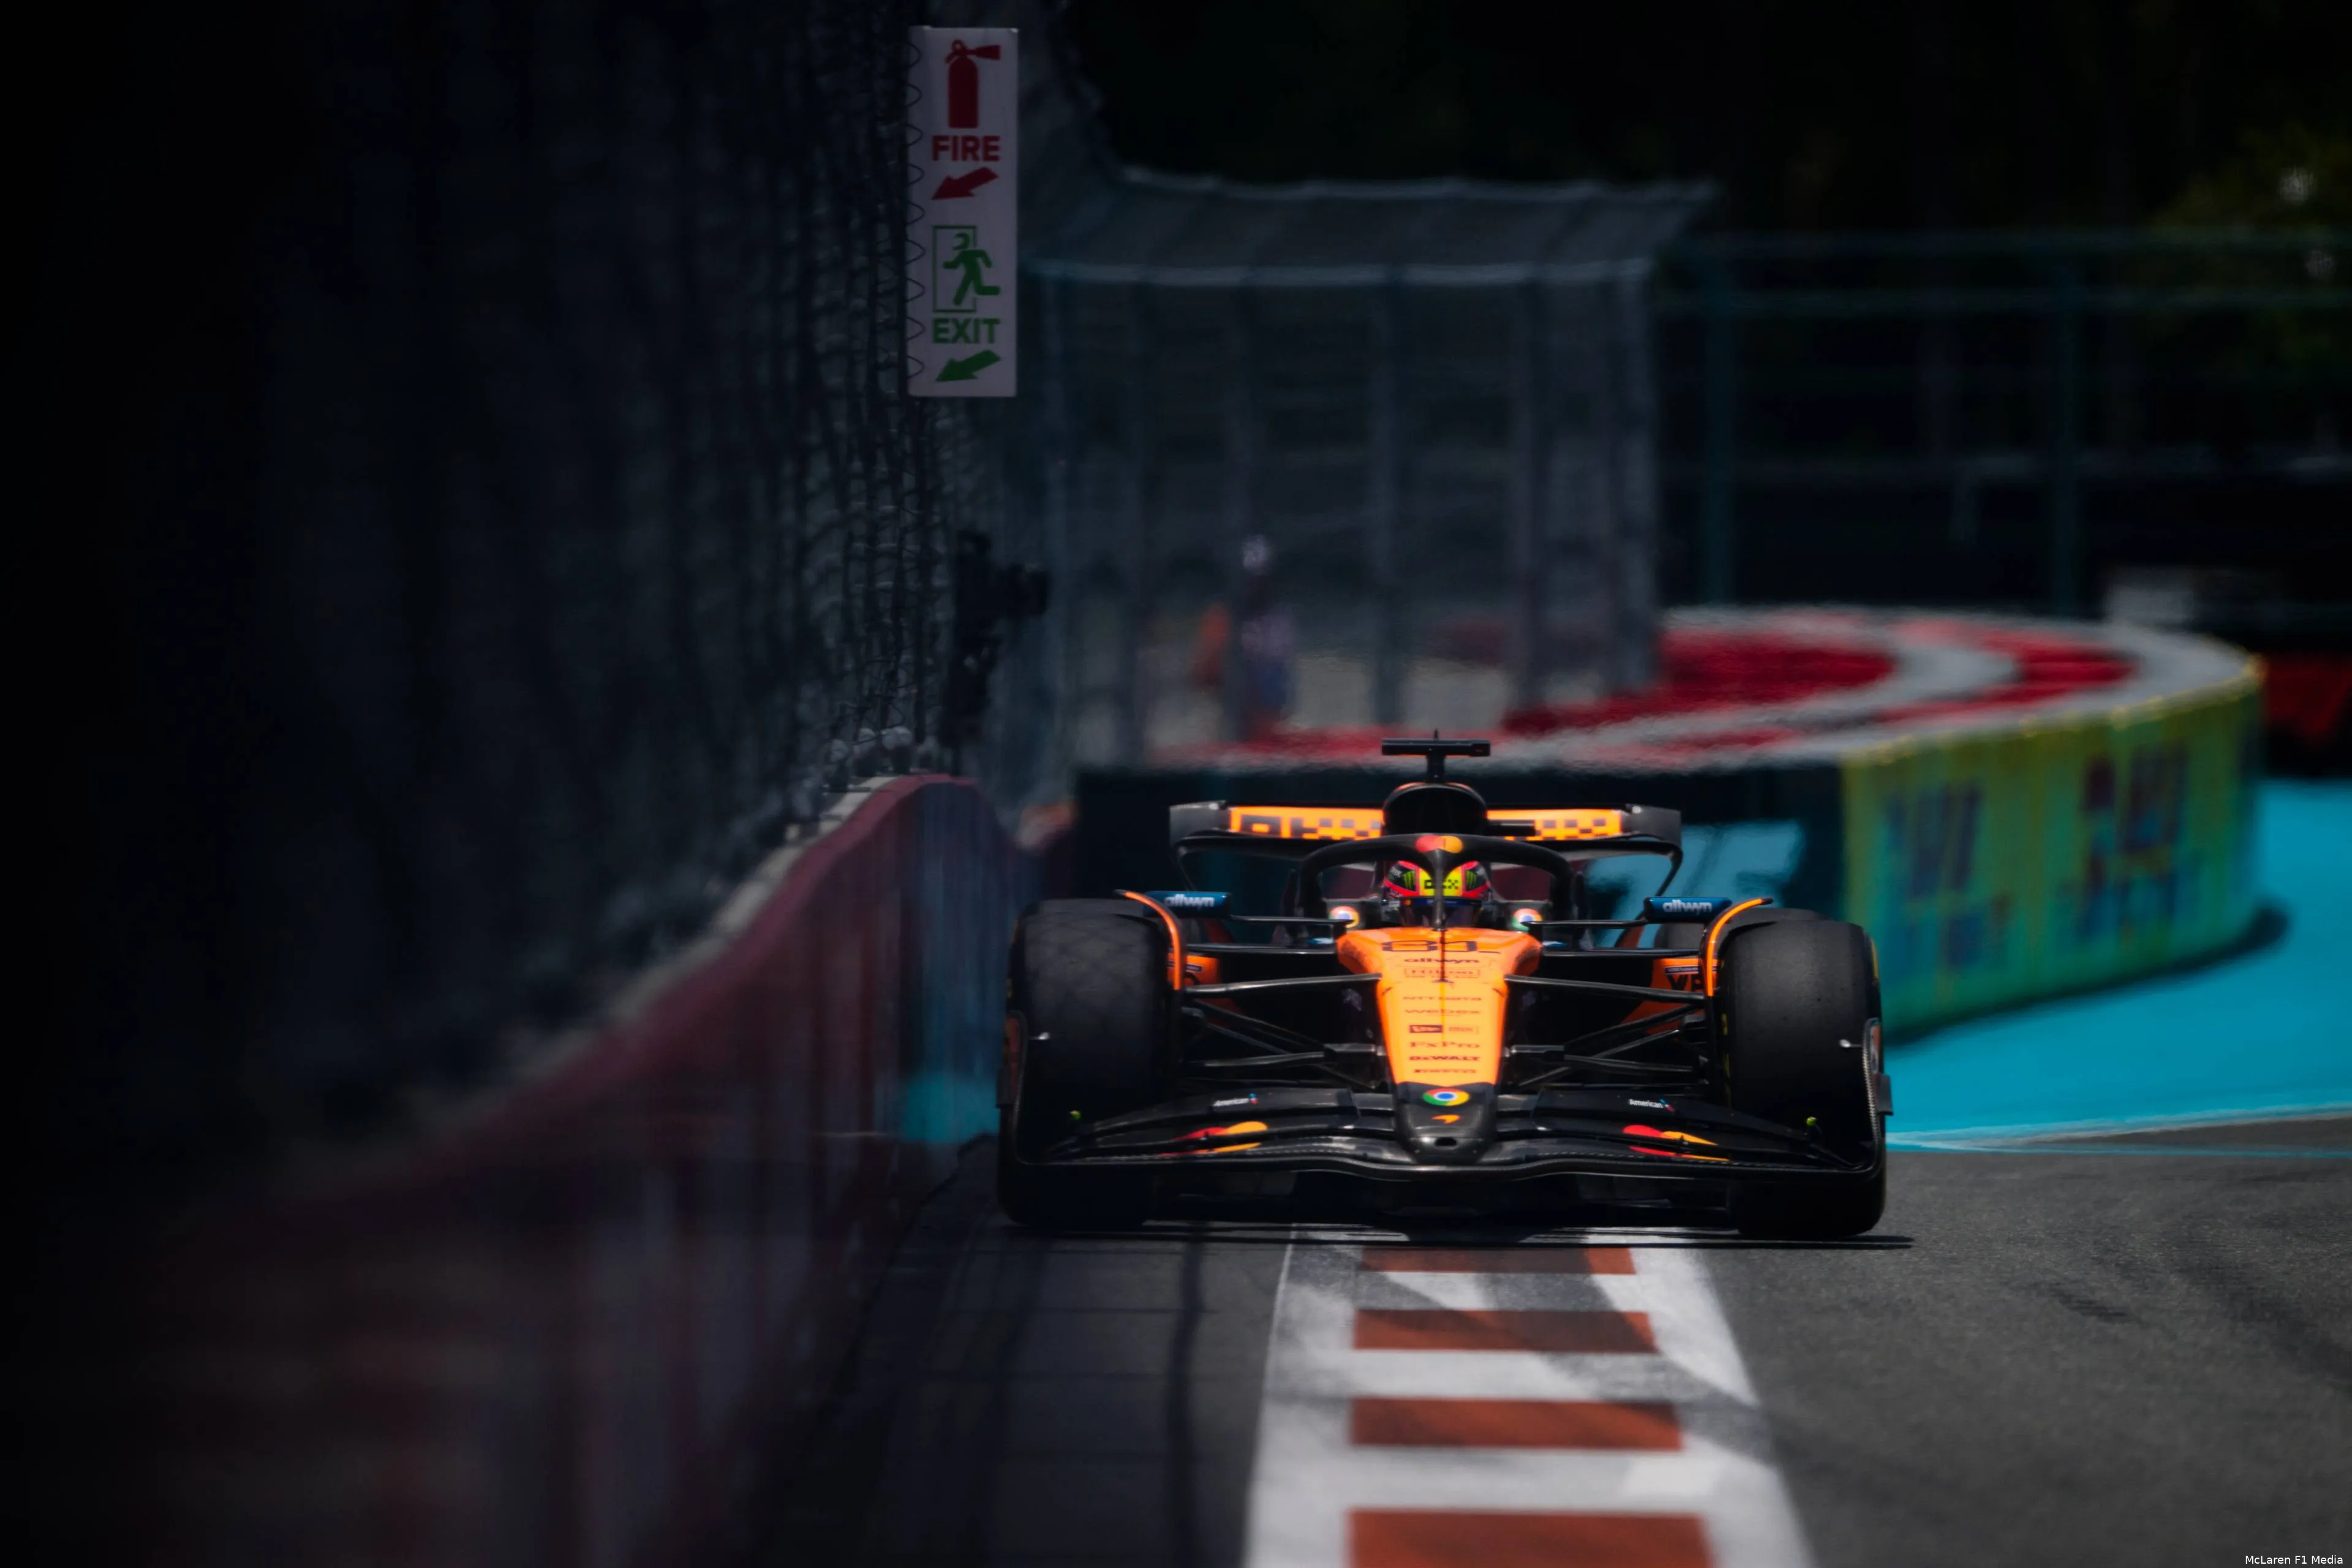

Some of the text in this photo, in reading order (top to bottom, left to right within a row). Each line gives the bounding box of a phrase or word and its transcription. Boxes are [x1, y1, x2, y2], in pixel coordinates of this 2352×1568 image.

[932, 135, 1001, 161] FIRE
[932, 318, 1001, 344] EXIT
[1164, 894, 1215, 910] allwyn
[1662, 899, 1713, 914] allwyn
[1381, 940, 1500, 954] 81
[1213, 1097, 1250, 1107] American
[1628, 1098, 1664, 1108] American
